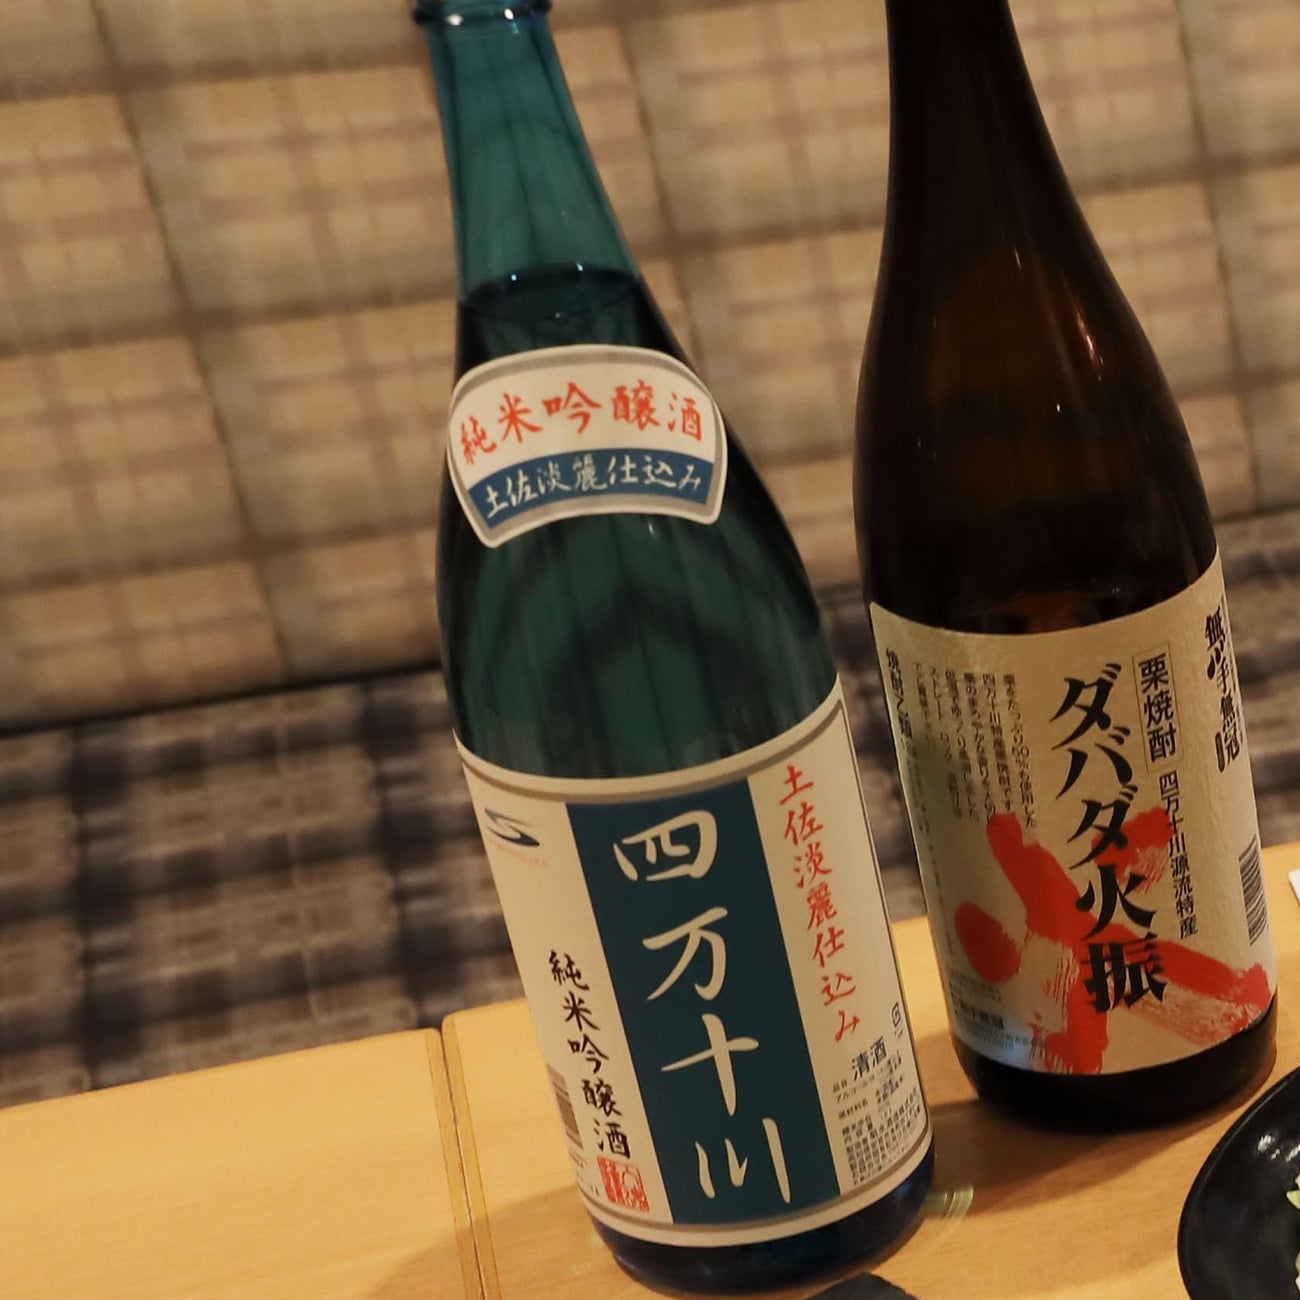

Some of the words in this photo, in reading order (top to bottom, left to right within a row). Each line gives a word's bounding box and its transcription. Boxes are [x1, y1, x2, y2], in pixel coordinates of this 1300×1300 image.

[459, 379, 703, 465] 純米吟醸酒
[486, 452, 702, 519] 土佐淡麗仕込み
[1138, 653, 1178, 760] 栗焼酎
[779, 764, 861, 1043] 土佐淡麗仕込み
[1050, 661, 1168, 1013] ダバダ火振
[1158, 769, 1199, 940] 四万十川源流特産
[548, 949, 631, 1160] 純米吟醸酒
[612, 810, 791, 1204] 四万十川
[851, 1036, 887, 1082] 清酒
